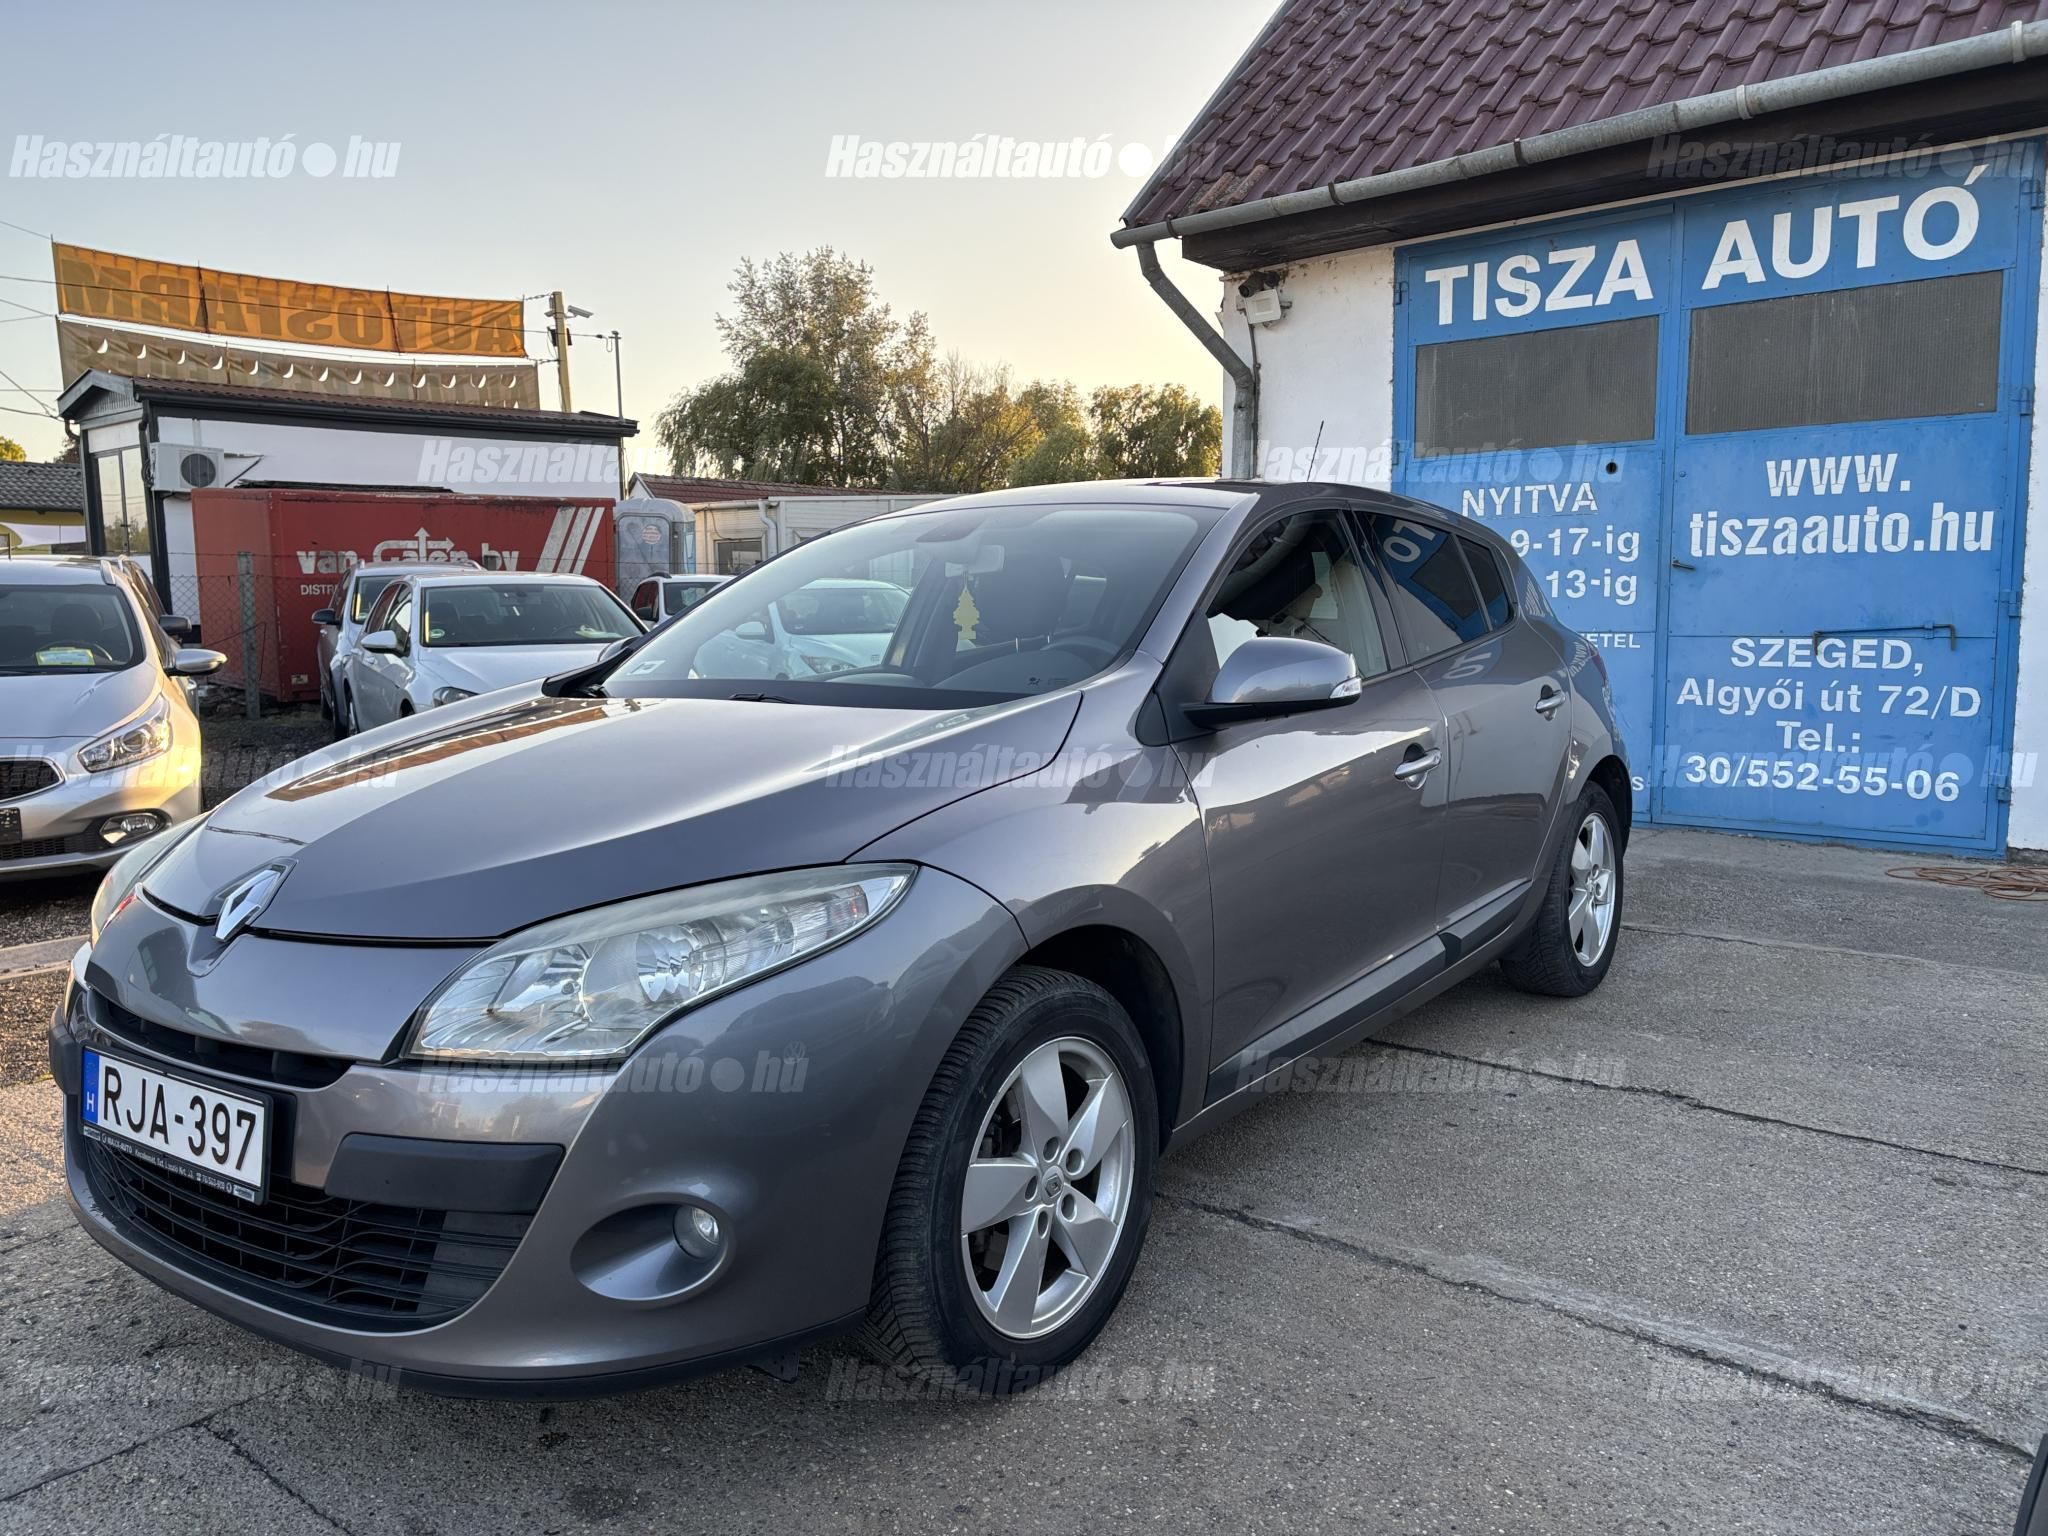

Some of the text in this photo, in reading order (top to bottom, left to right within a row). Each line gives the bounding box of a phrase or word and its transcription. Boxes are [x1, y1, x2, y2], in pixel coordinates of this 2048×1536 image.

[1425, 164, 1989, 325] TISZA AUTÓ
[1766, 453, 1910, 497] www.
[1462, 482, 1598, 517] NYITVA
[1690, 502, 1994, 557] tiszaauto.hu
[296, 550, 358, 574] van
[1731, 637, 1924, 677] SZEGED,
[1677, 678, 1981, 720] Algyői út 72/D
[1776, 720, 1861, 753] Tel.:
[1685, 755, 1960, 802] 30/552-55-06
[87, 1092, 95, 1113] H
[103, 1065, 256, 1171] RJA-397
